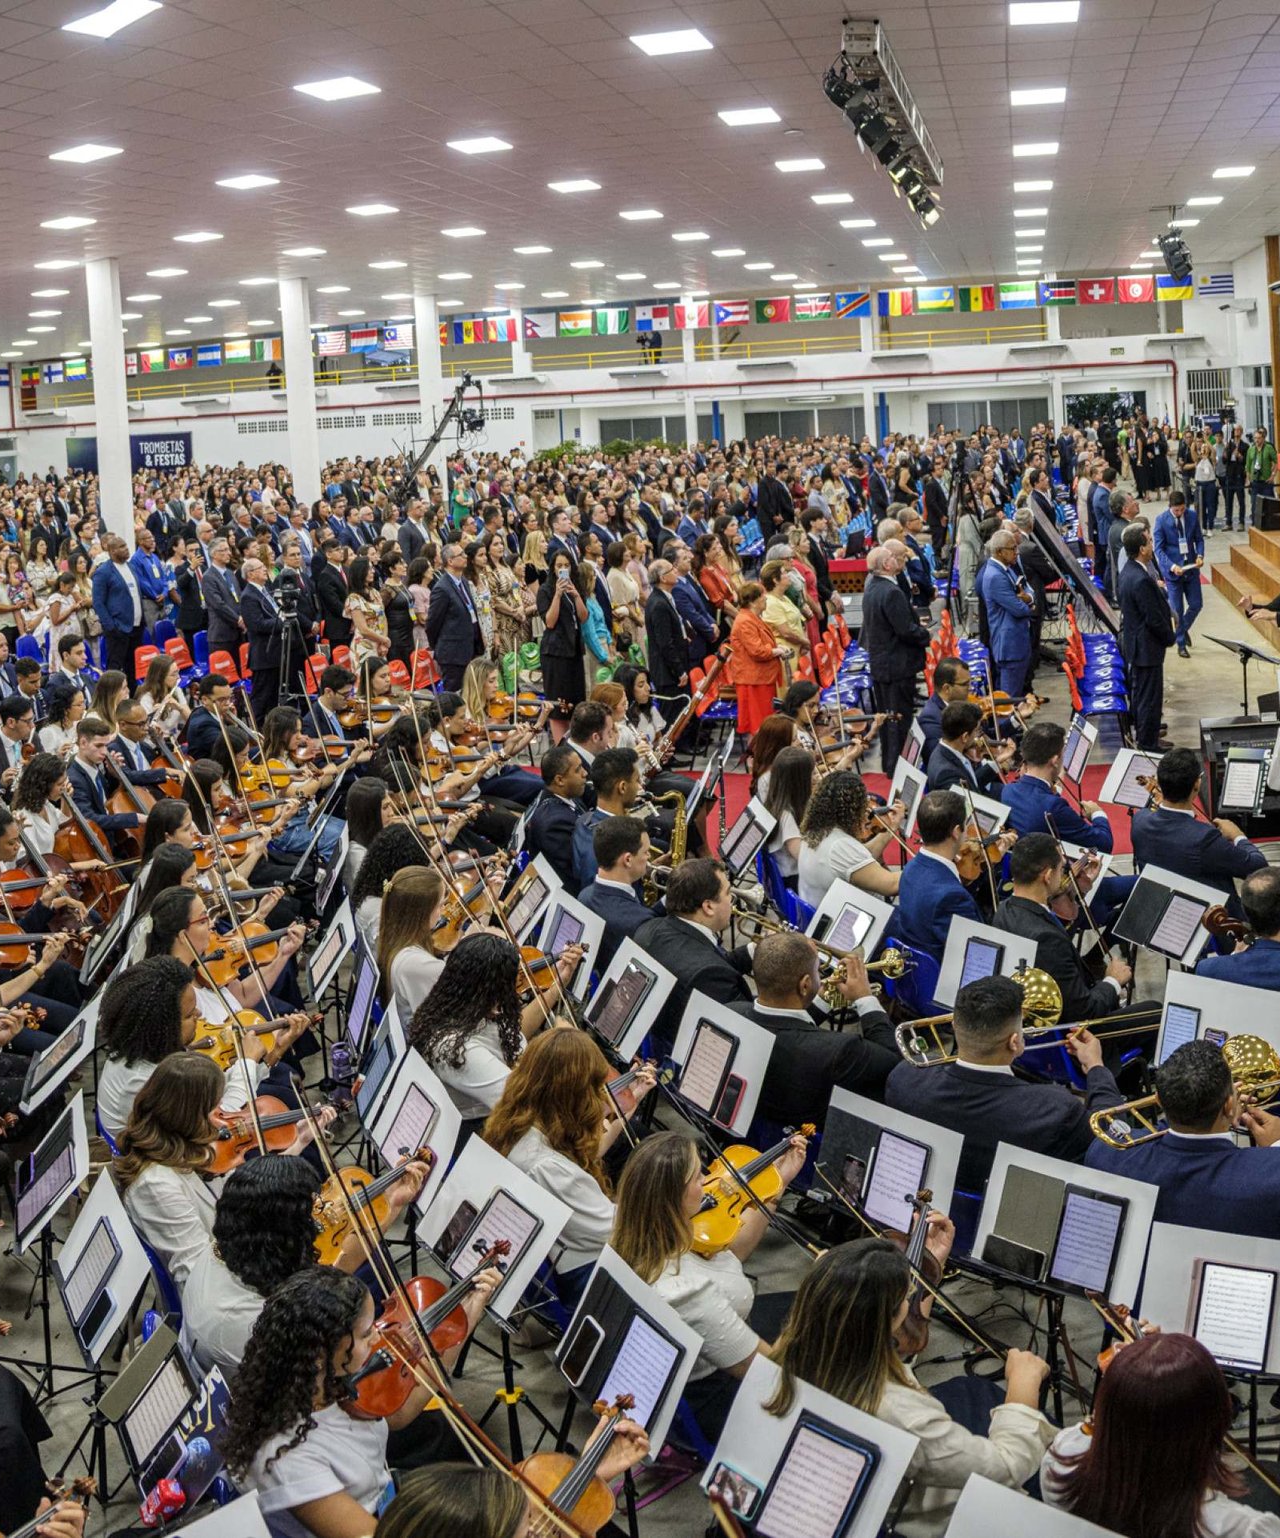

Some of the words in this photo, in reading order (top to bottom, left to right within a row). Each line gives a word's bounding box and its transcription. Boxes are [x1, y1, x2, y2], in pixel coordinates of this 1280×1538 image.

[139, 440, 185, 454] TROMBETAS
[145, 455, 153, 466] &
[154, 453, 186, 466] FESTAS
